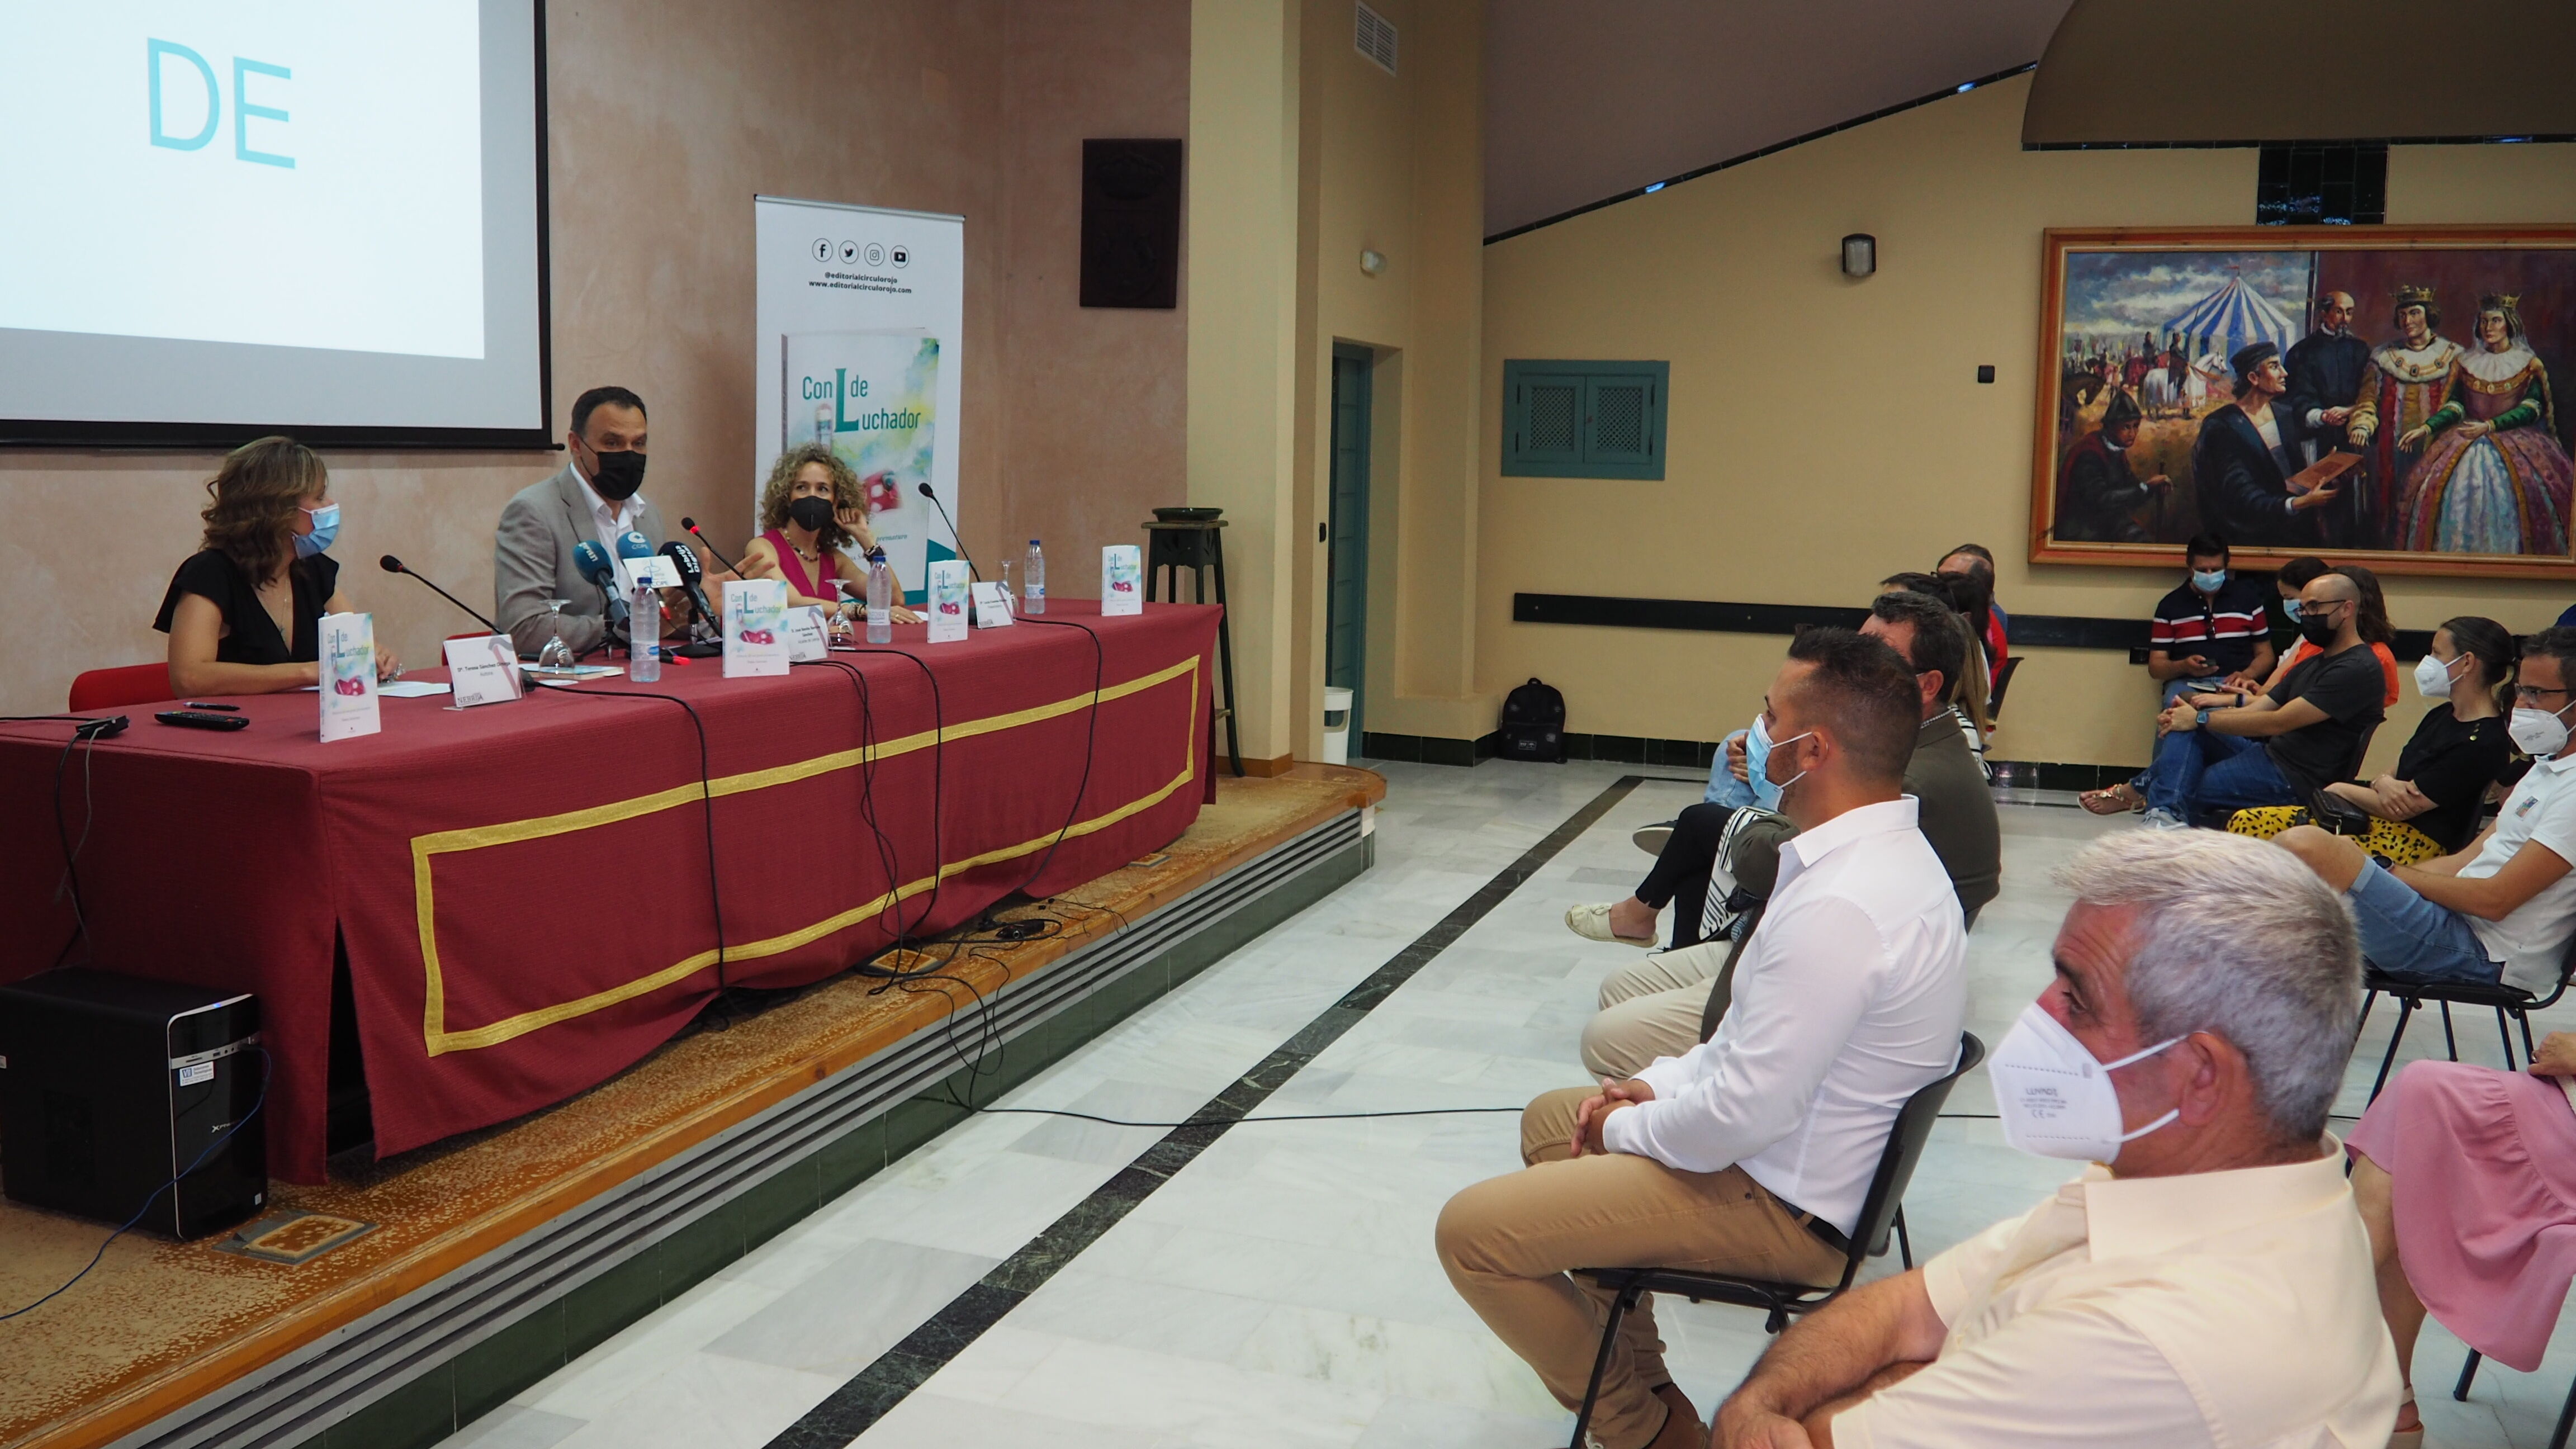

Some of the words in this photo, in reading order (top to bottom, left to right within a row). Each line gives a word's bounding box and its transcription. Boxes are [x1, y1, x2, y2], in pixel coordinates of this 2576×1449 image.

[148, 37, 295, 169] DE
[808, 281, 912, 293] www.editorialcirculorojo.com
[825, 272, 897, 284] @editorialcirculorojo
[803, 376, 832, 400] Con
[850, 375, 868, 397] de
